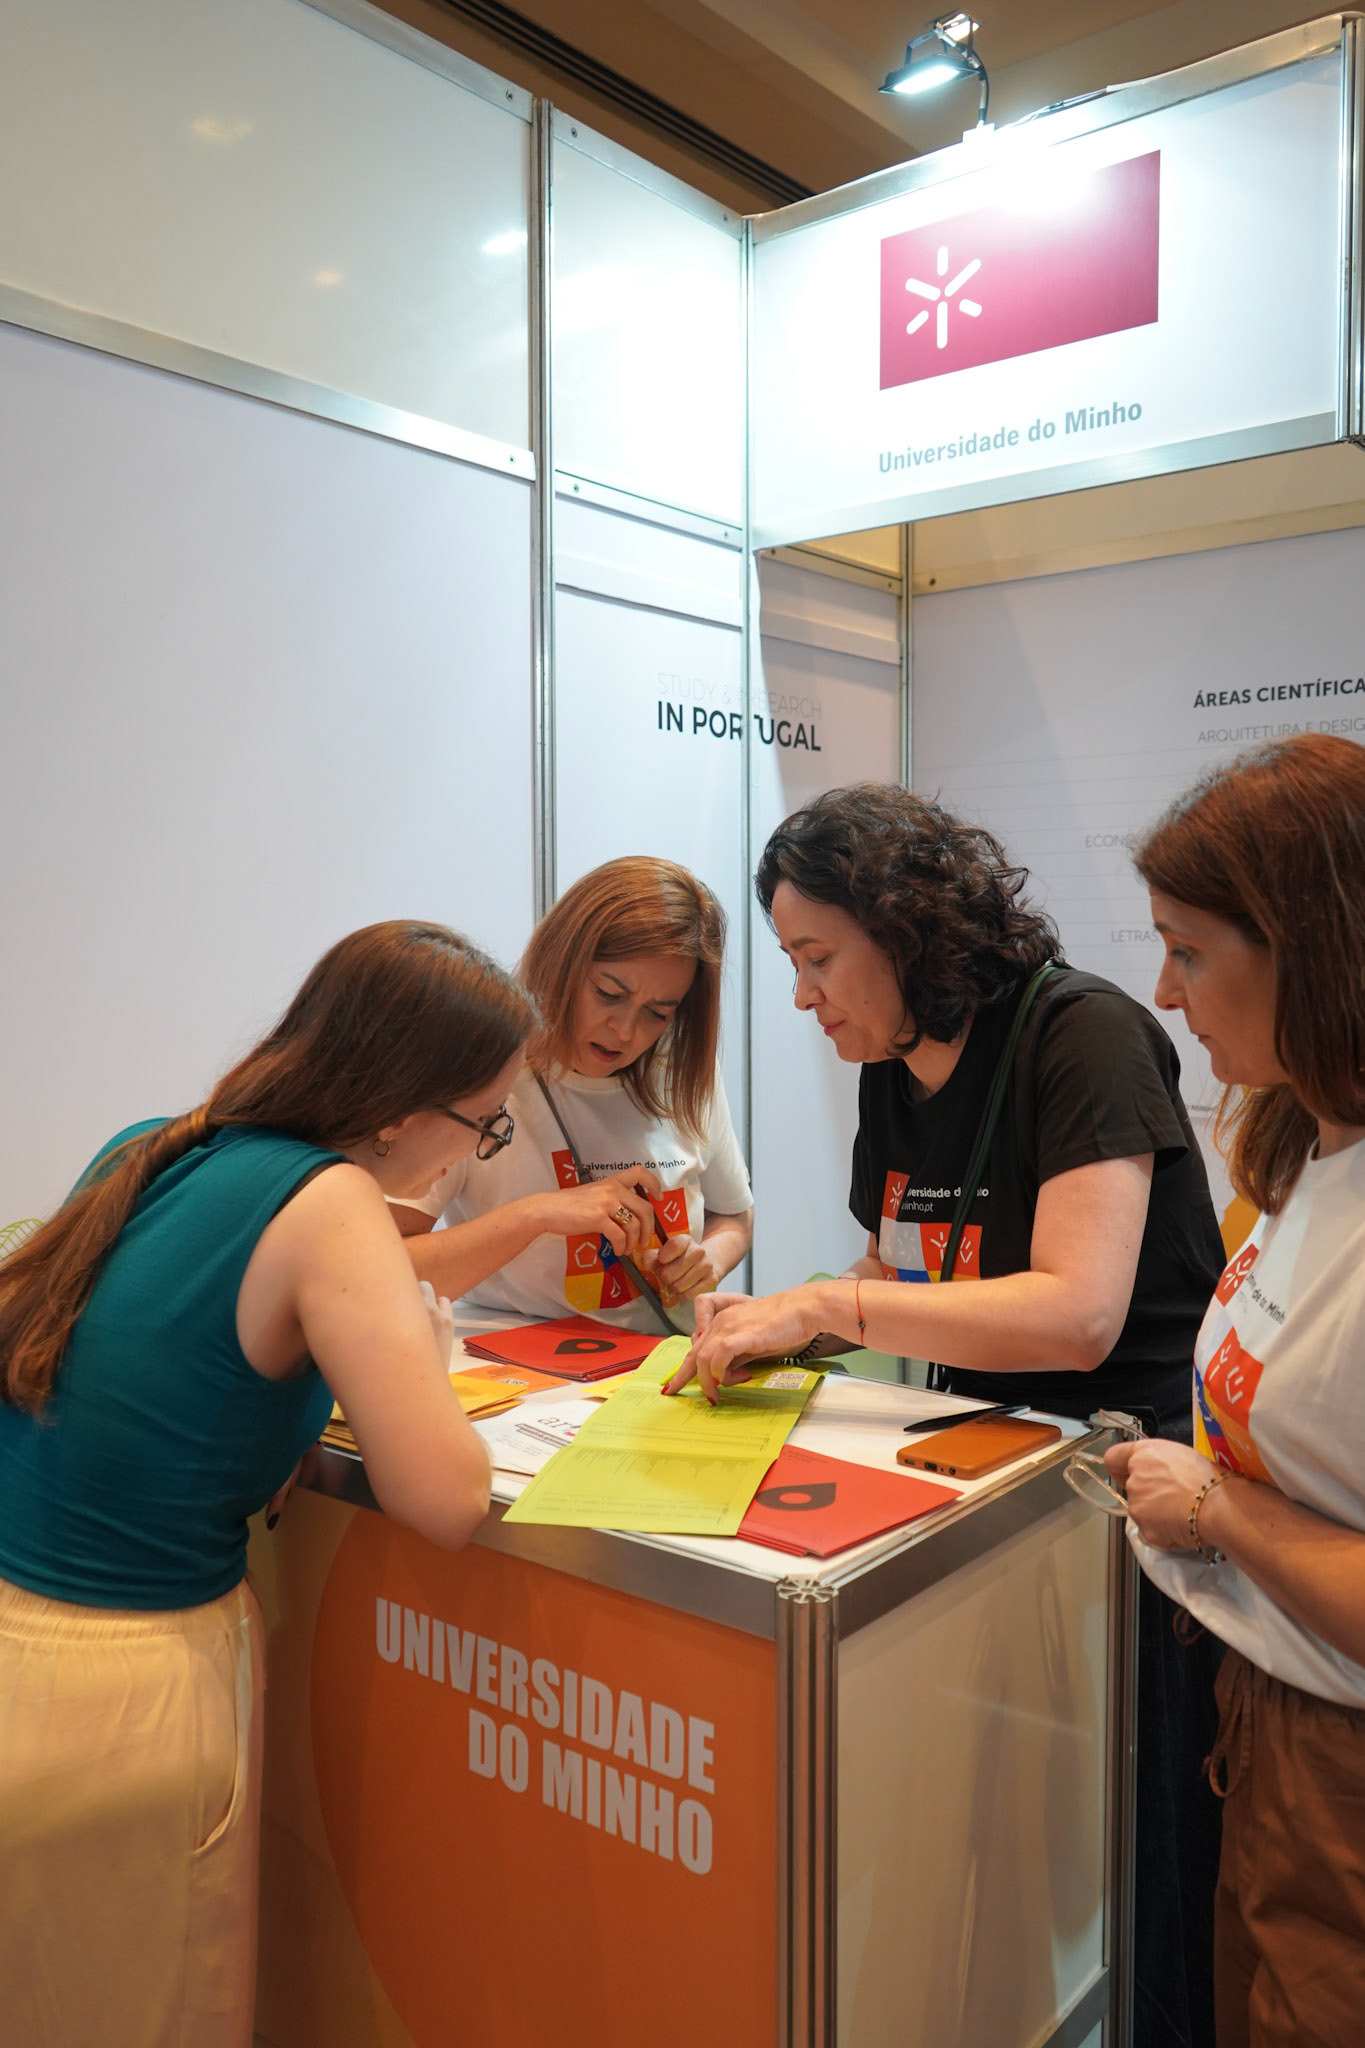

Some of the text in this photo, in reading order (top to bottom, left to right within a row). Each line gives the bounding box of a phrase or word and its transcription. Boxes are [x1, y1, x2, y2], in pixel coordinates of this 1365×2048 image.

[878, 401, 1142, 473] Universidade do Minho
[1193, 678, 1365, 708] ÁREAS CIENTÍFICA
[658, 700, 683, 733] IN
[1197, 724, 1301, 744] ARQUITETURA
[644, 1160, 657, 1169] do
[658, 1160, 686, 1170] Minho
[953, 1186, 962, 1197] d
[375, 1596, 715, 1795] UNIVERSIDADE
[468, 1707, 713, 1876] DO MINHO
